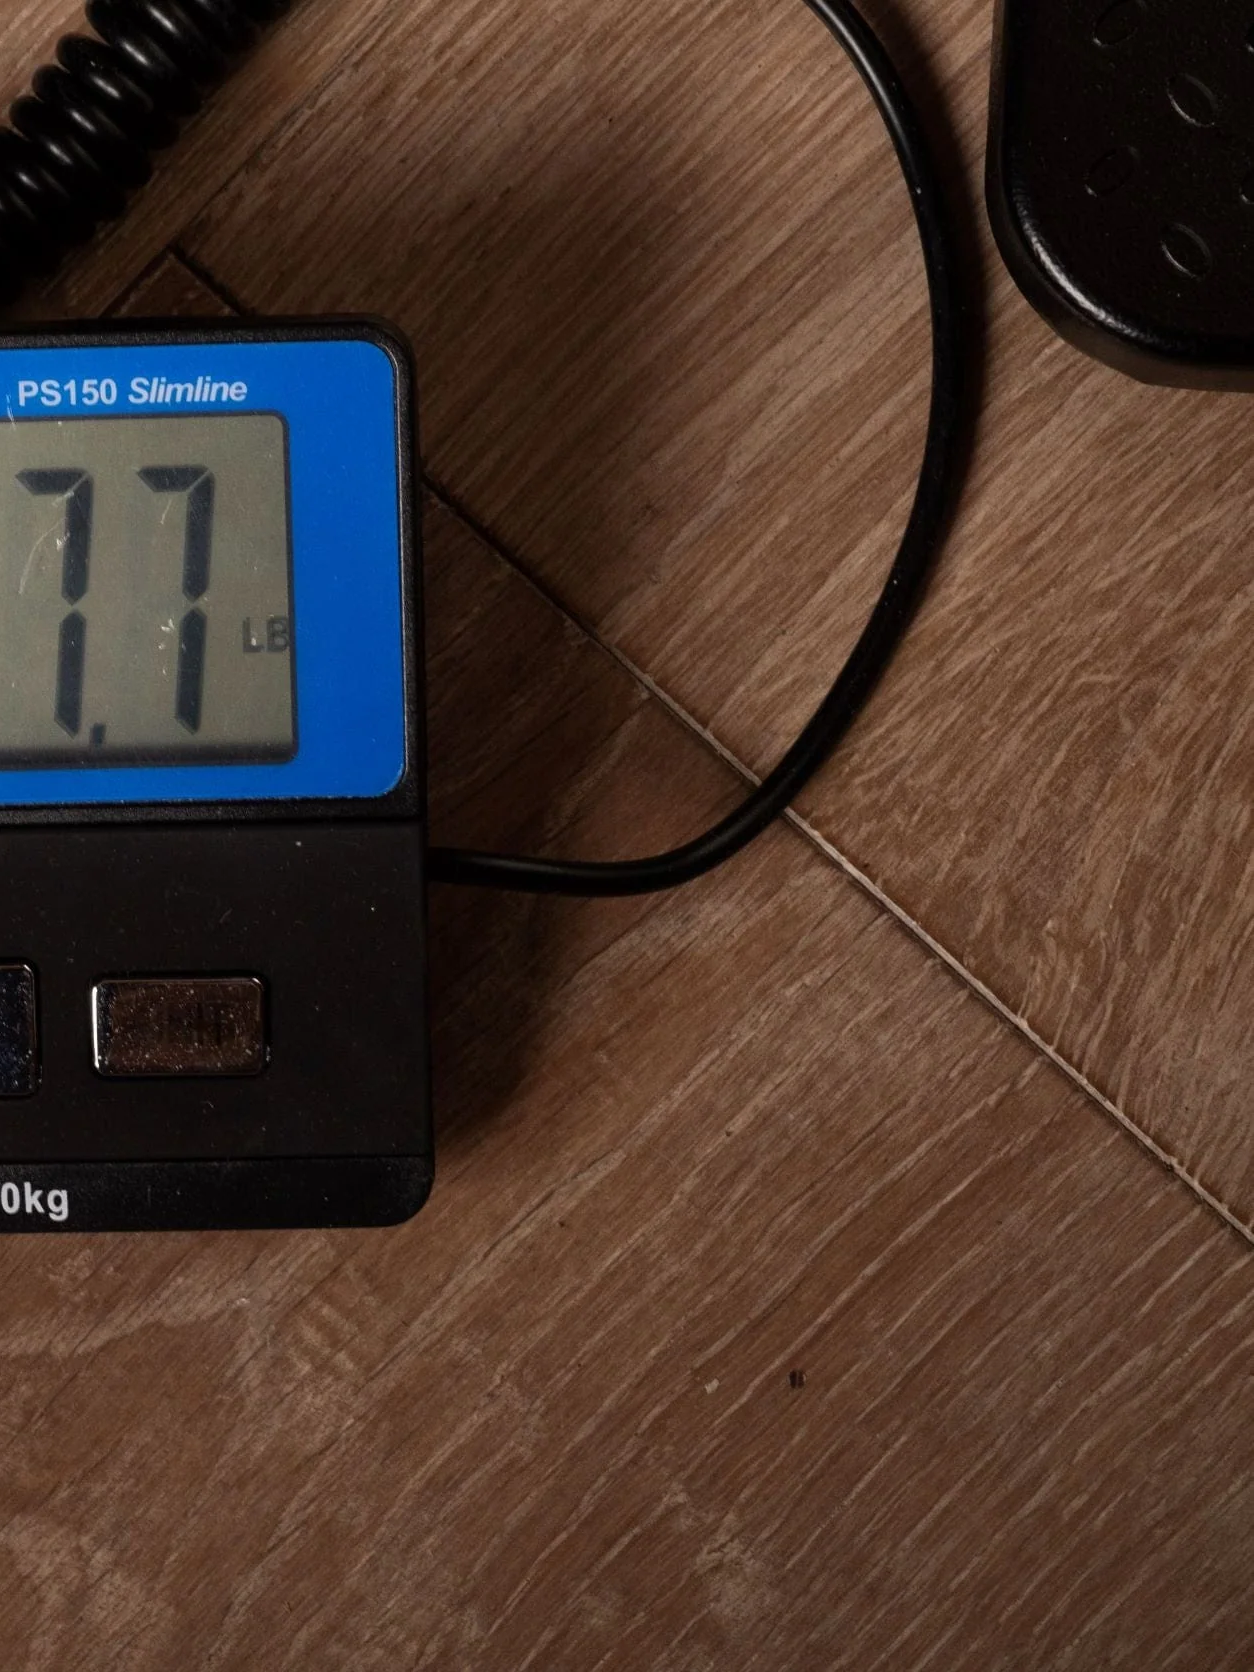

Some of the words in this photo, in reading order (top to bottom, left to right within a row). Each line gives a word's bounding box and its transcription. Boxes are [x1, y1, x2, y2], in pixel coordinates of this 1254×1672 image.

[17, 378, 117, 407] PS150
[128, 375, 247, 404] Slimline
[242, 615, 289, 653] LB
